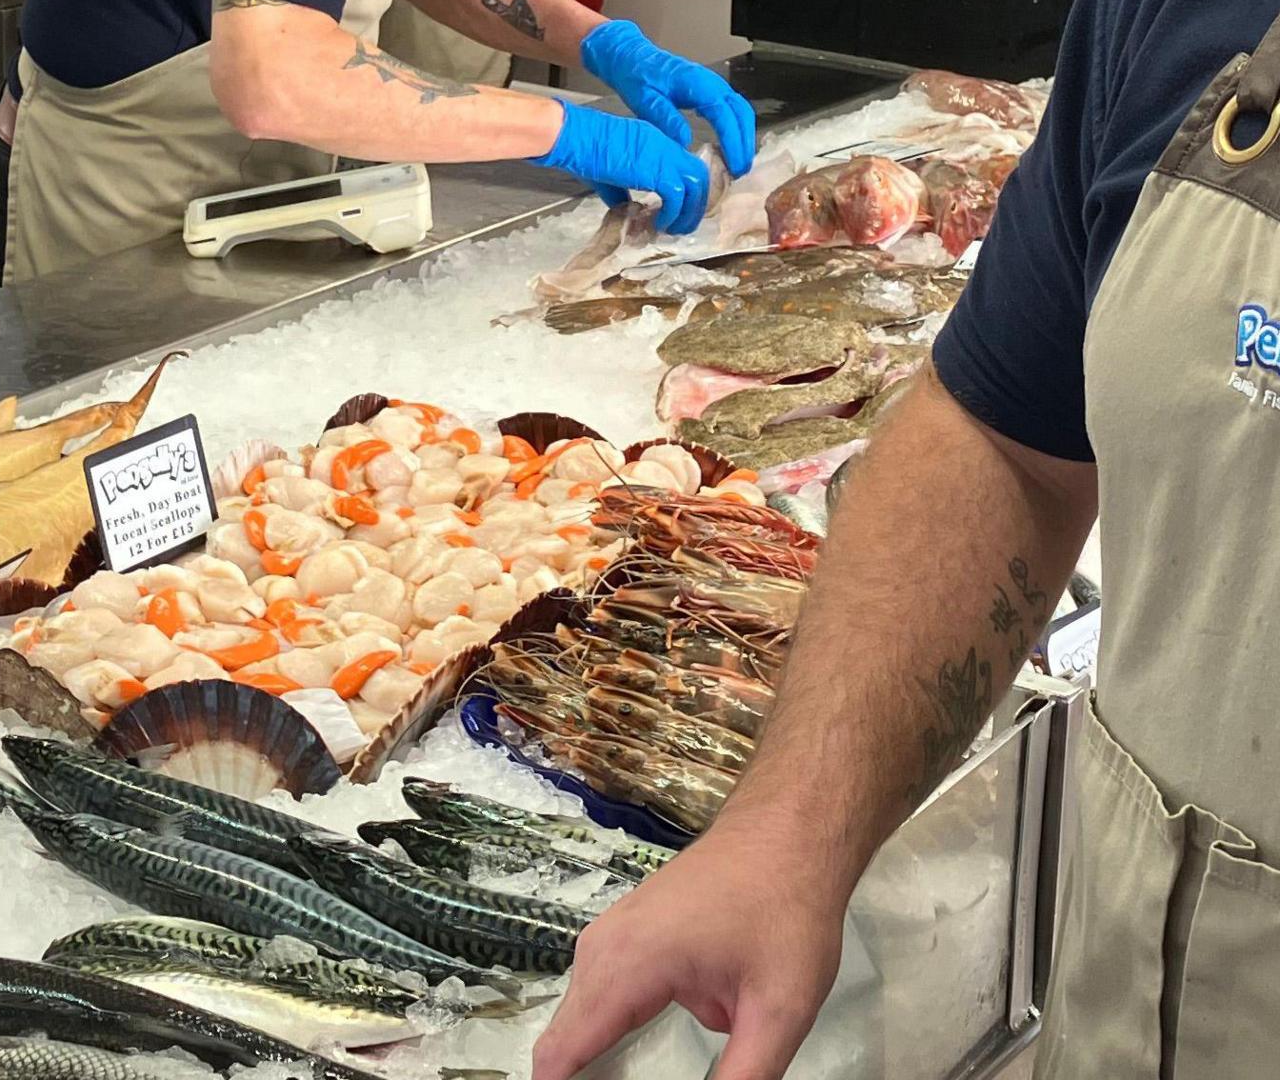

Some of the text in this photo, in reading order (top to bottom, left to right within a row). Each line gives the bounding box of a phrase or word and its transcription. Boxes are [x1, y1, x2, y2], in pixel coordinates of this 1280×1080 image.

[105, 484, 202, 530] Fresh, Day Boat
[114, 503, 201, 546] Local Scallops
[129, 521, 194, 558] 12 For £15
